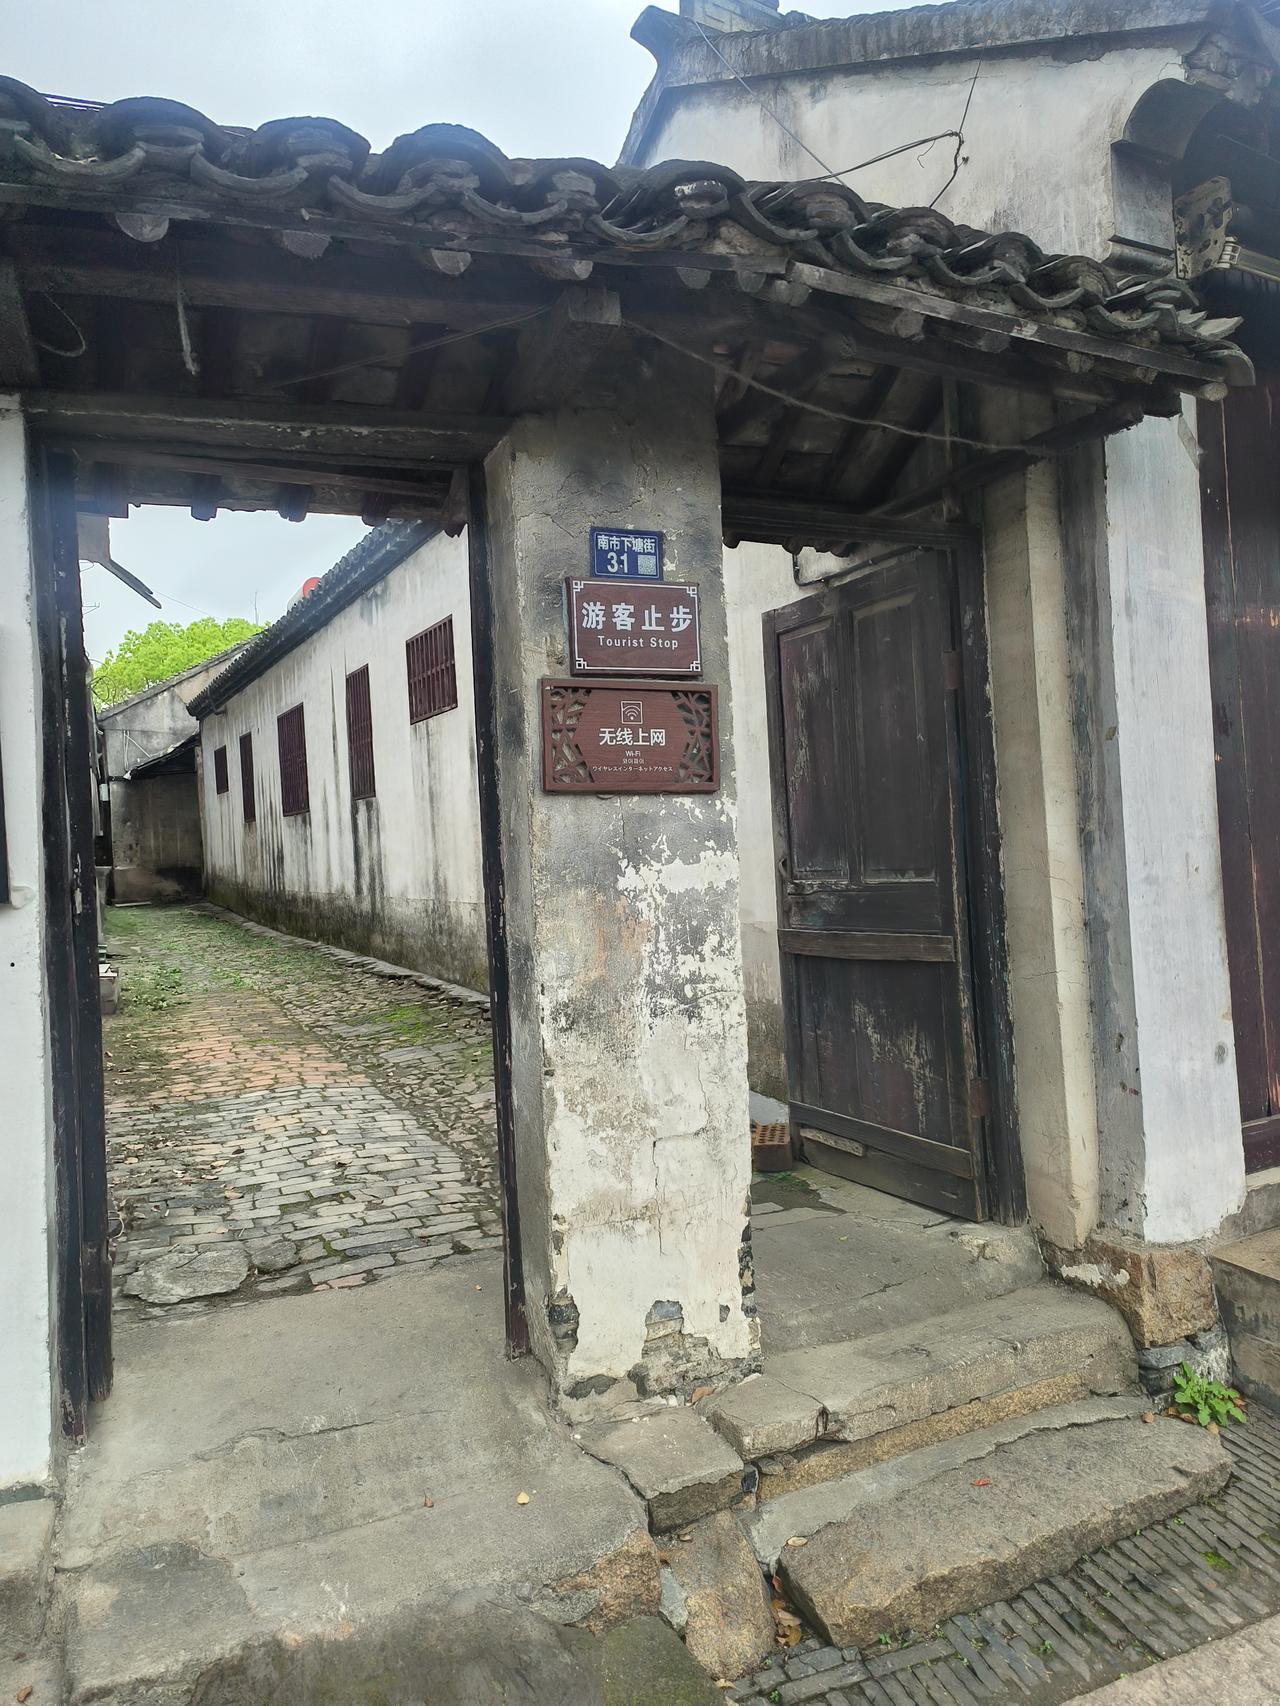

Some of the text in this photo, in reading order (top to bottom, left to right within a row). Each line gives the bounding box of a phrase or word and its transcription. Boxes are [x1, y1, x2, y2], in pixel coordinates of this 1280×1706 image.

[597, 534, 656, 553] 南市下塘街
[607, 551, 628, 573] 31
[581, 601, 693, 632] 游客止步
[597, 635, 678, 650] Tourist Stop
[599, 728, 666, 746] 无线上网
